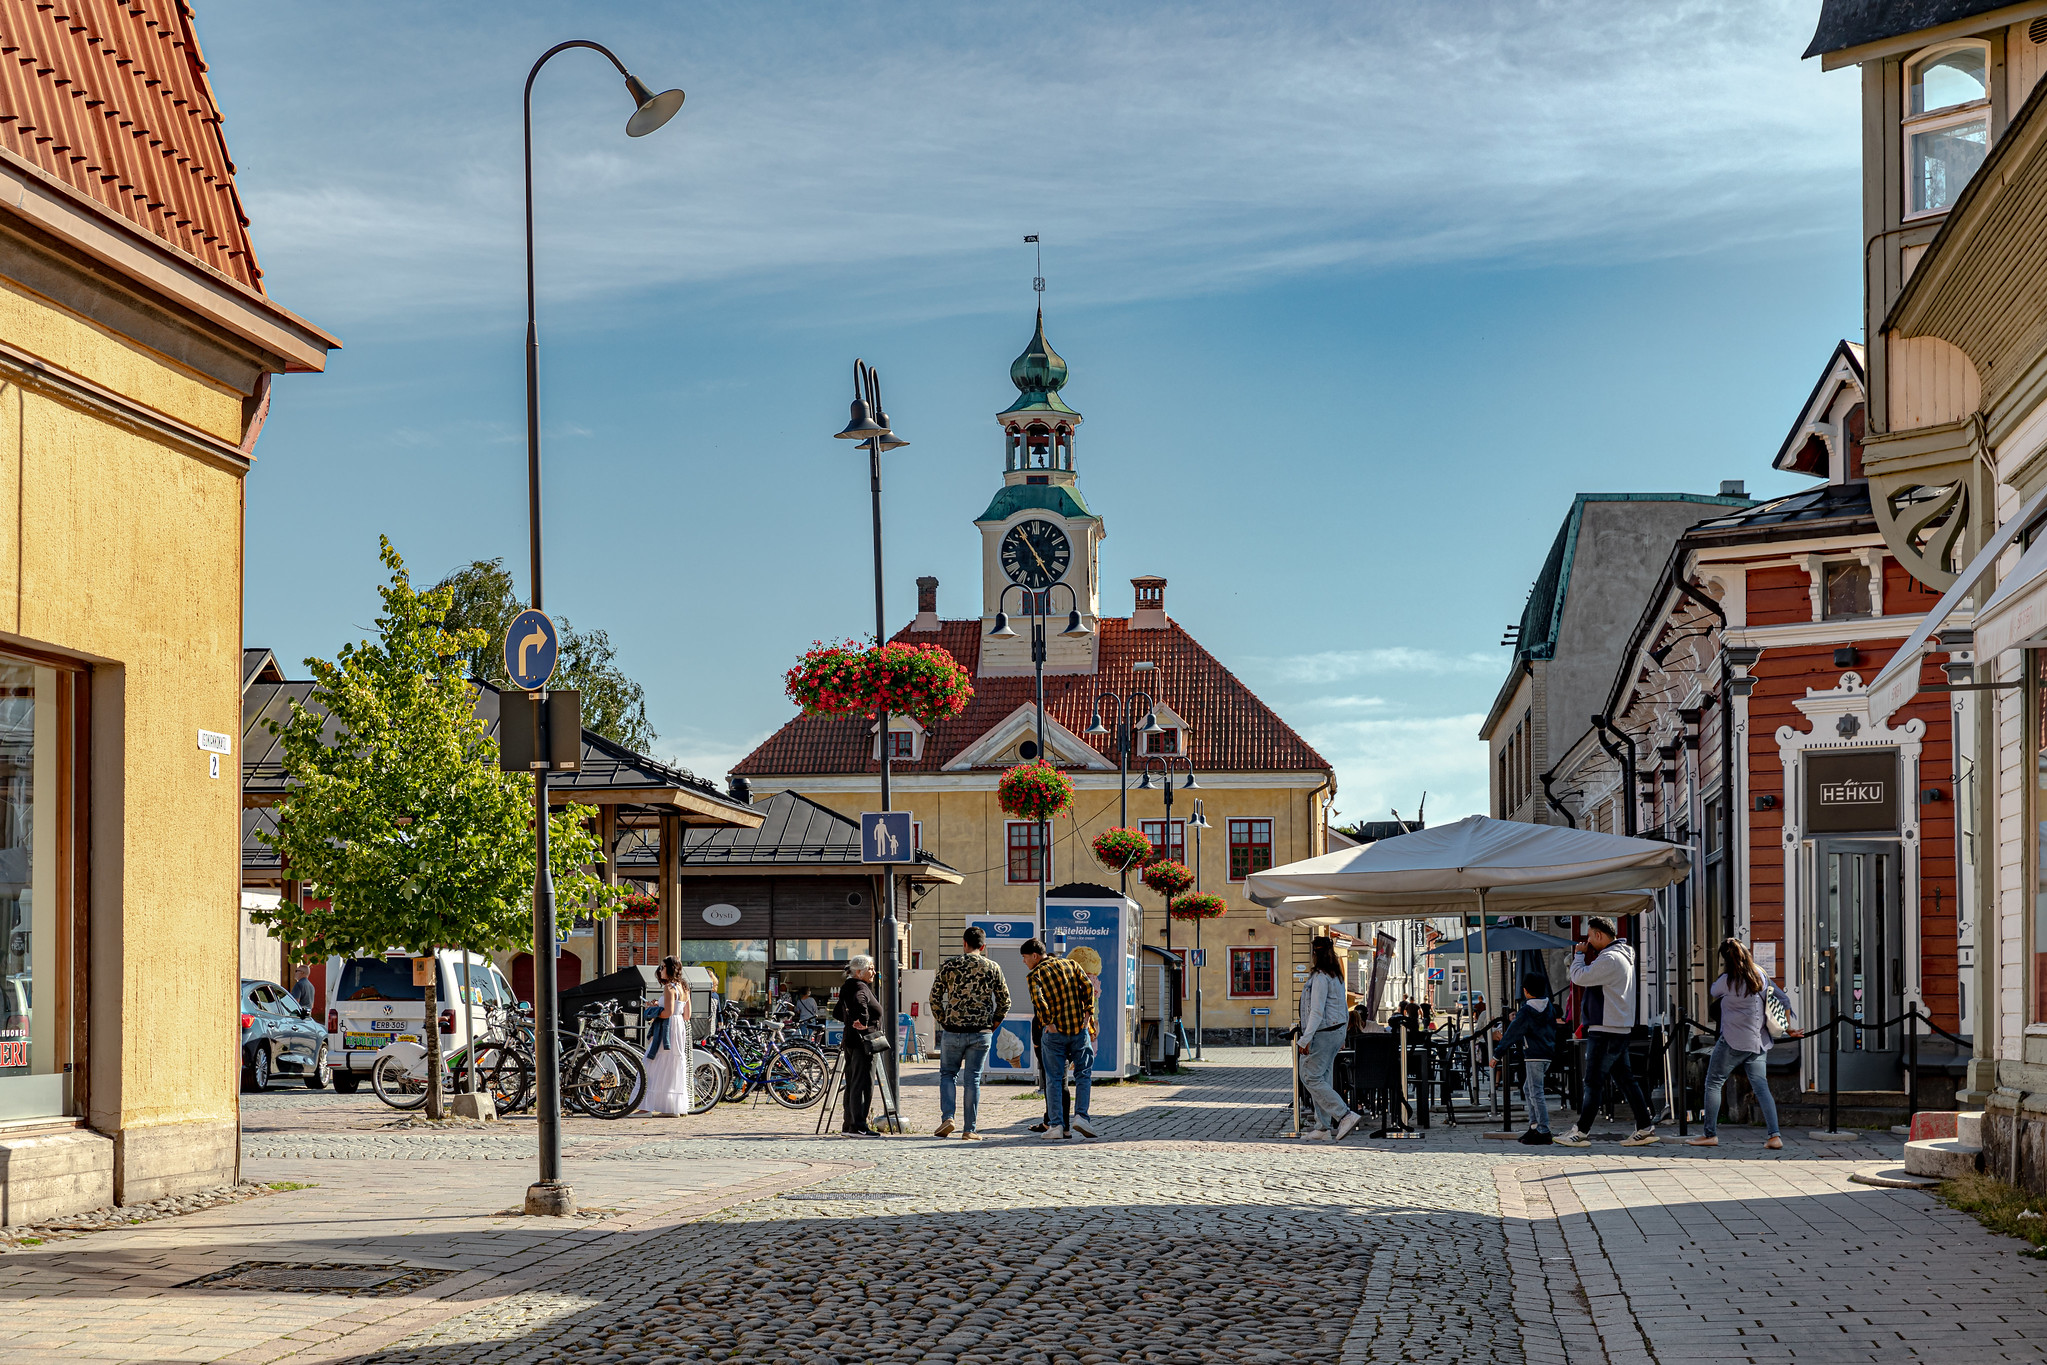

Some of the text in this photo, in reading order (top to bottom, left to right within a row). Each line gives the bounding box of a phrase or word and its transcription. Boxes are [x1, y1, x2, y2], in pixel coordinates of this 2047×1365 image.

[1031, 521, 1040, 535] XII
[1006, 536, 1019, 547] X
[212, 756, 217, 776] 2
[1823, 786, 1880, 801] HEHKU
[376, 1021, 405, 1029] ERB-305
